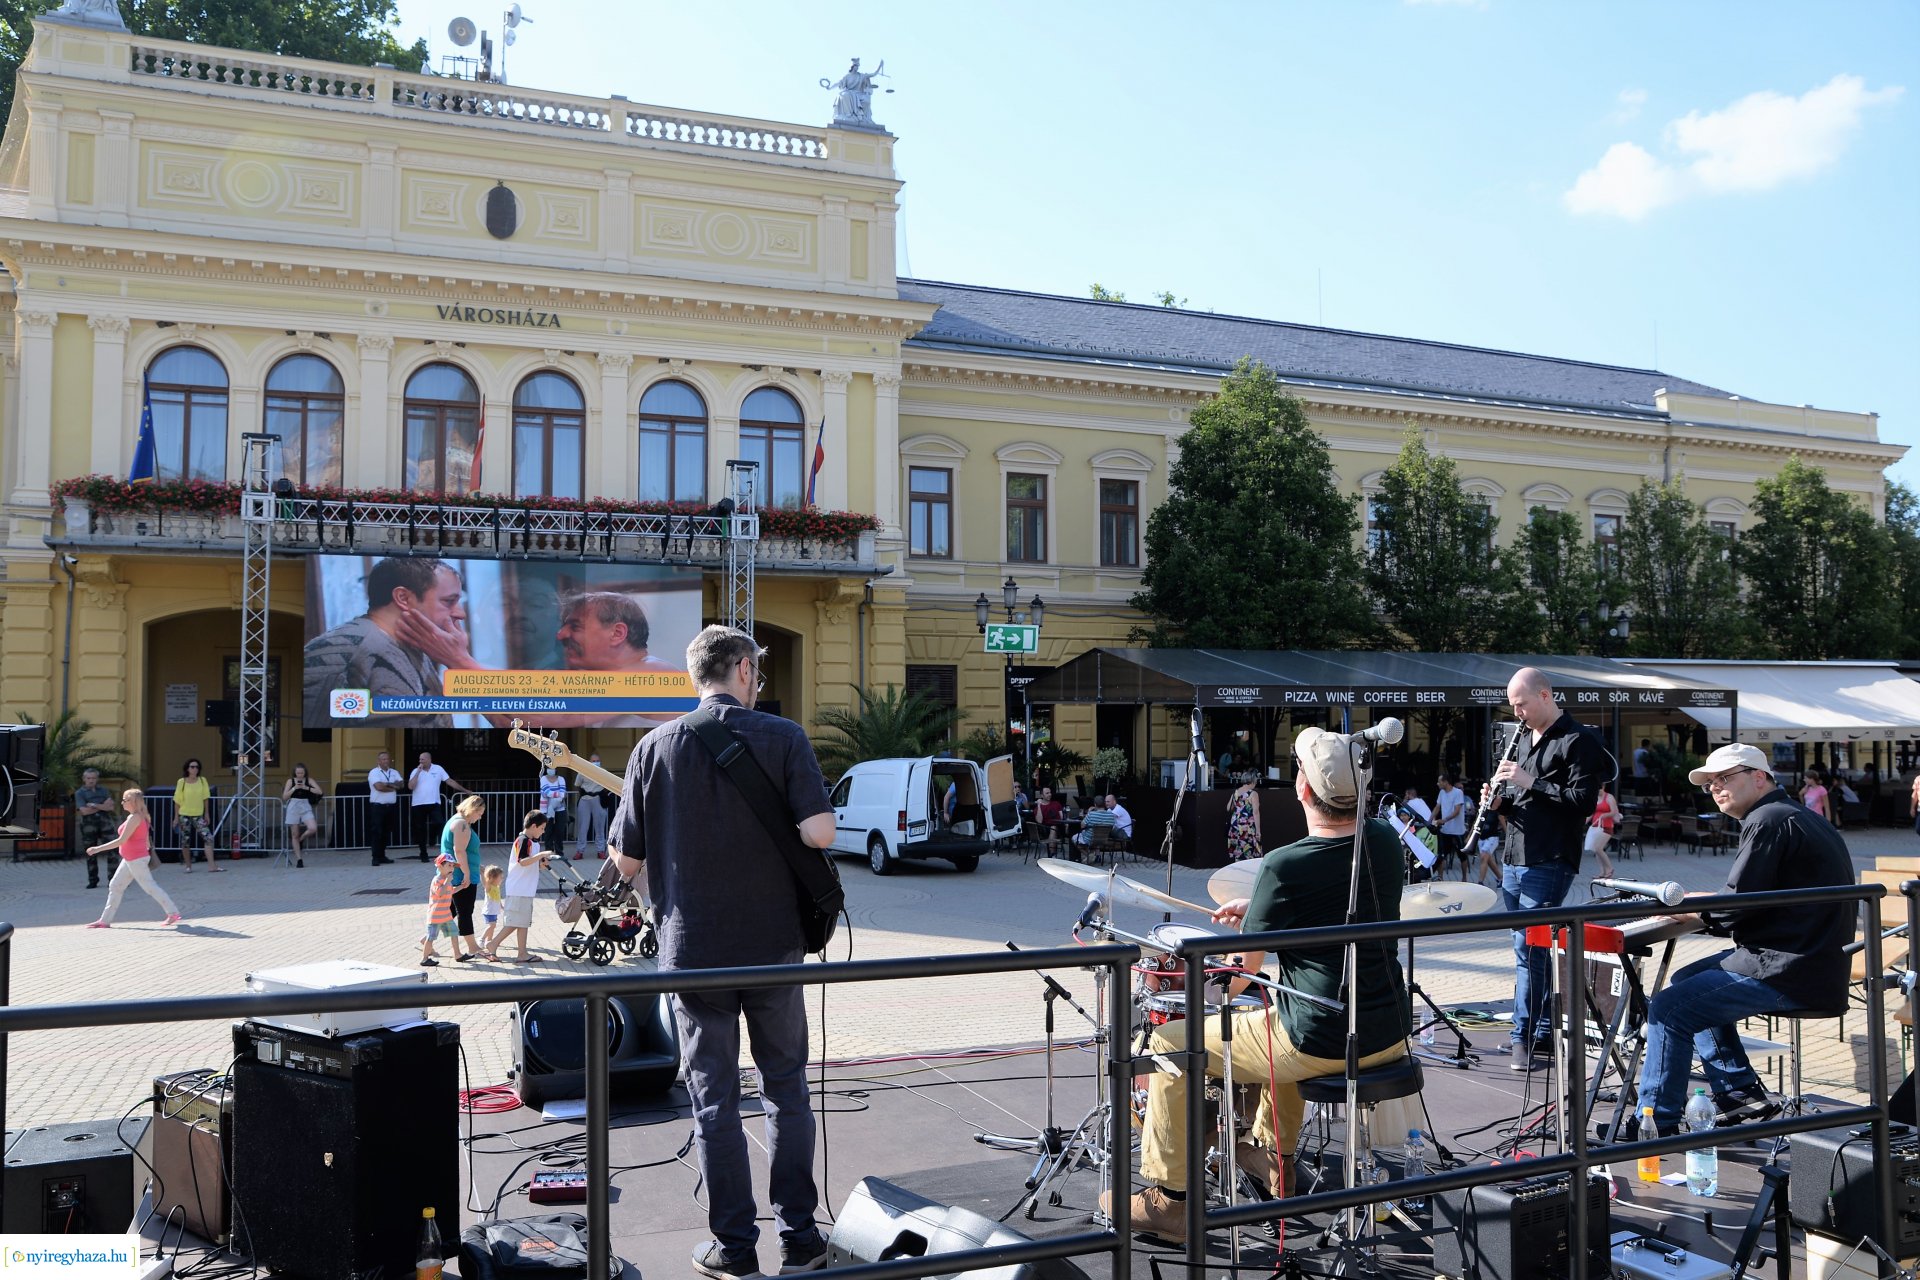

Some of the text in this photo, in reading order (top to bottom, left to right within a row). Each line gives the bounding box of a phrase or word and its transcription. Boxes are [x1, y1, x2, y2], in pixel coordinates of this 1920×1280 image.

[437, 302, 561, 328] VÁROSHÁZA
[453, 675, 516, 685] AUGUSZTUS
[519, 676, 532, 685] 23
[542, 676, 559, 685] 24.
[562, 674, 615, 686] VASÁRNAP
[659, 676, 686, 686] 19.00
[1217, 687, 1260, 696] CONTINENT
[1284, 691, 1446, 703] PIZZA WINE COFFEE BEER
[1470, 688, 1508, 697] CONTINENT
[1577, 692, 1600, 702] BOR
[1608, 690, 1630, 702] SÖR
[1639, 690, 1665, 703] KÁVÉ
[1691, 691, 1725, 700] CONTINENT
[381, 698, 459, 710] NÉZŐMŰVÉSZETI
[461, 700, 481, 710] KFT.
[491, 701, 525, 710] ELEVEN
[528, 699, 567, 710] ÉJSZAKA
